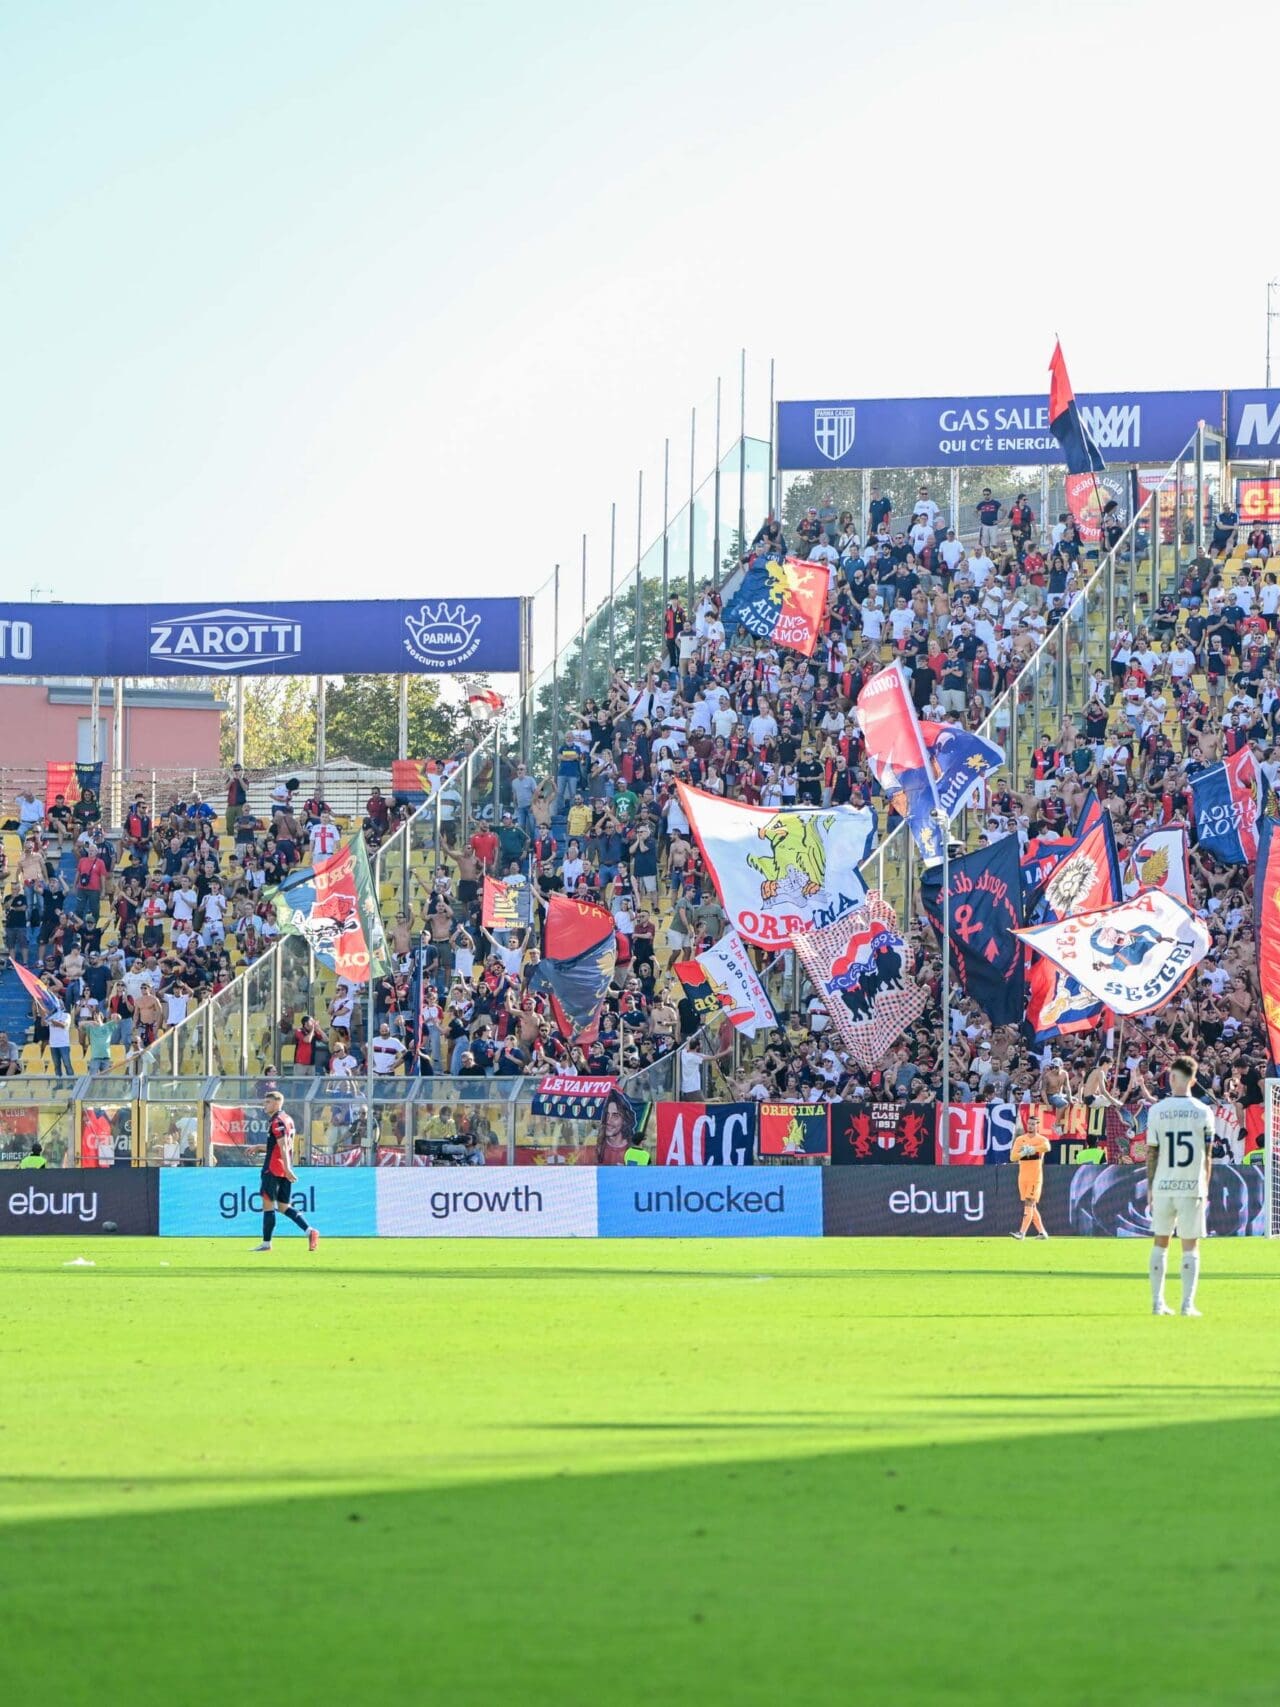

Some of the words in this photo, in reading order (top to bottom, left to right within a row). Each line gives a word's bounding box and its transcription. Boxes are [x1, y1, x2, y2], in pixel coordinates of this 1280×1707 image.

[939, 410, 992, 432] GAS
[995, 407, 1050, 431] SALE
[939, 439, 966, 454] QUI
[998, 436, 1061, 451] ENERGIA
[150, 624, 302, 655] ZAROTTI
[403, 638, 446, 668] PROSCIUTTO
[447, 658, 457, 667] DI
[457, 638, 481, 664] PARMA
[423, 632, 463, 645] PARMA
[738, 892, 860, 941] OREINA
[1104, 939, 1196, 1001] SESTRI
[543, 1076, 612, 1094] LEVANTO
[761, 1104, 827, 1117] OREGINA
[871, 1111, 900, 1120] CLASS
[872, 1103, 901, 1112] FIRST
[666, 1111, 748, 1166] ACG
[1165, 1131, 1194, 1168] 15
[8, 1186, 98, 1222] ebury
[219, 1185, 316, 1219] gloal
[430, 1185, 543, 1219] growth
[634, 1184, 785, 1213] unlocked
[889, 1183, 984, 1222] ebury
